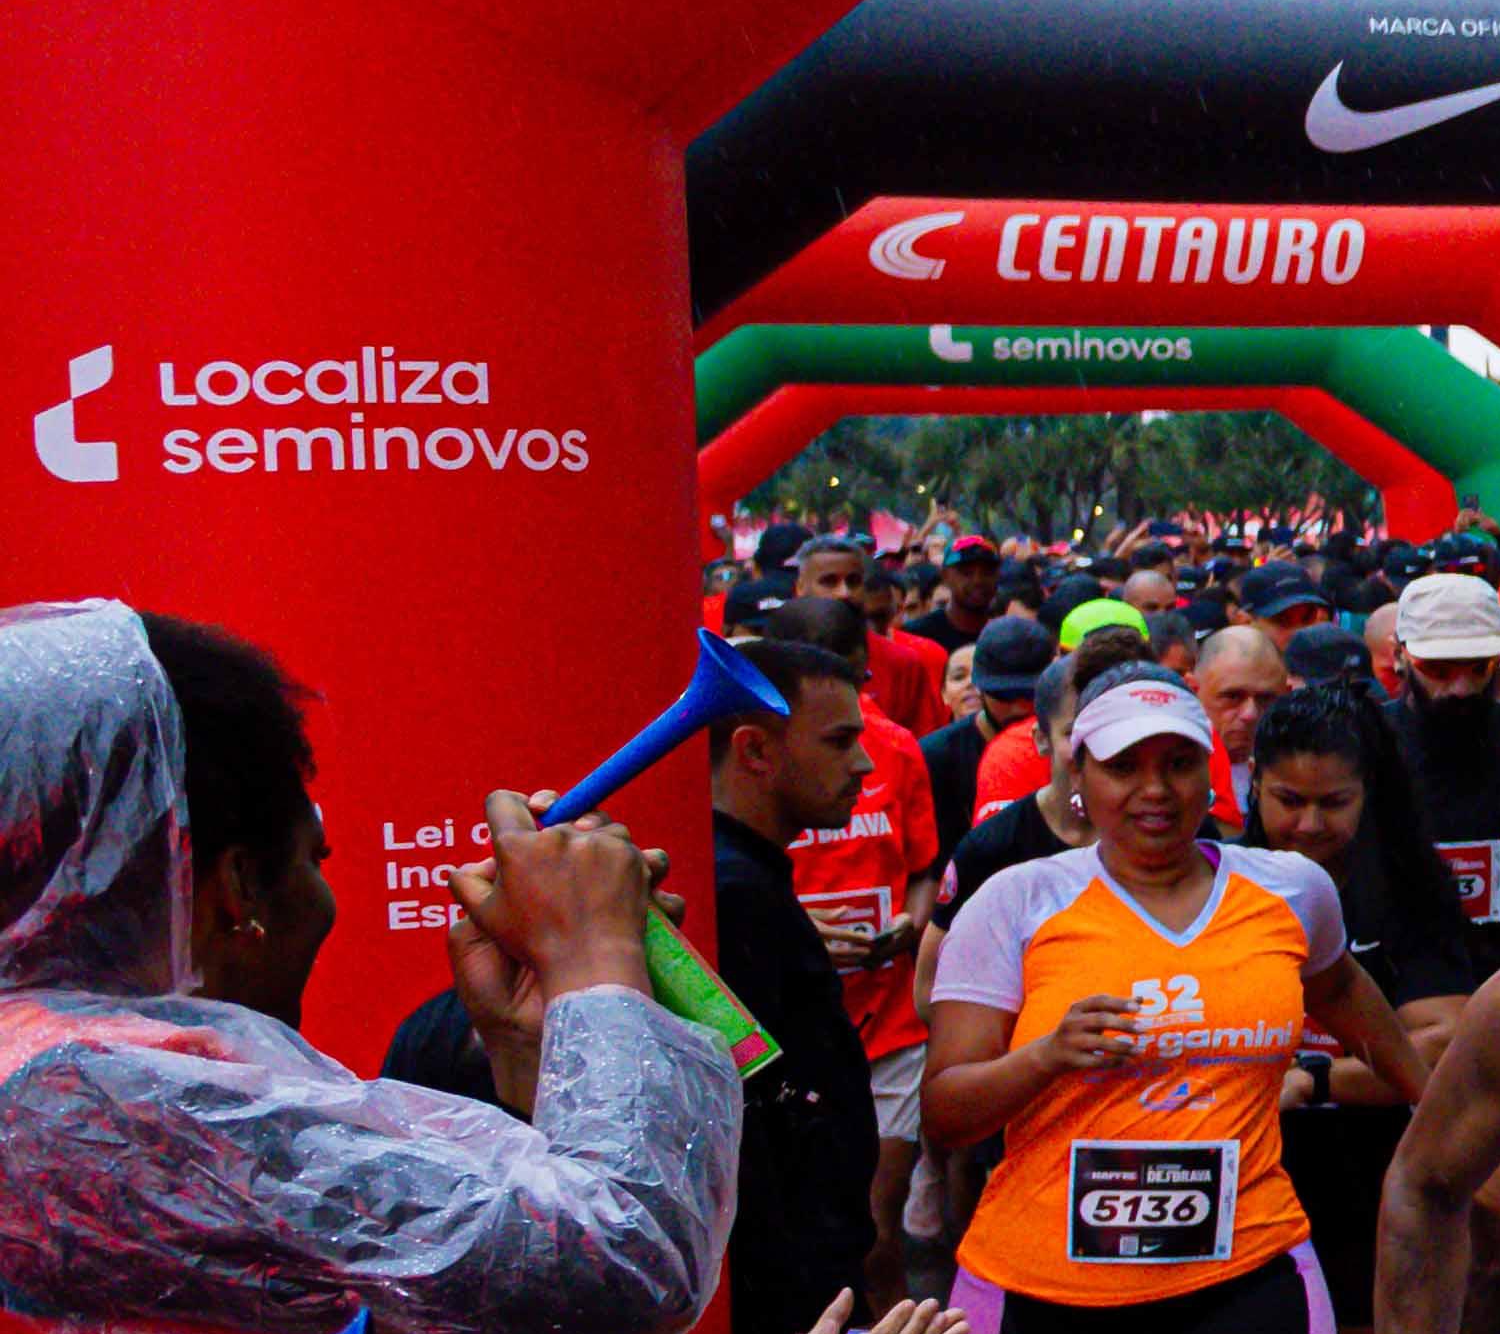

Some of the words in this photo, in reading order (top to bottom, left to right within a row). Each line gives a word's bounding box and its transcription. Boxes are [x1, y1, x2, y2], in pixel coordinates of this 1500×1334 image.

[1369, 15, 1456, 37] MARCA
[996, 213, 1366, 285] CENTAURO
[992, 329, 1193, 363] seminovos
[159, 345, 490, 405] Localiza
[162, 412, 590, 473] seminovos
[384, 819, 454, 850] Lei
[1132, 974, 1204, 1016] 52
[1112, 1019, 1295, 1058] ergamini
[1091, 1194, 1199, 1223] 5136
